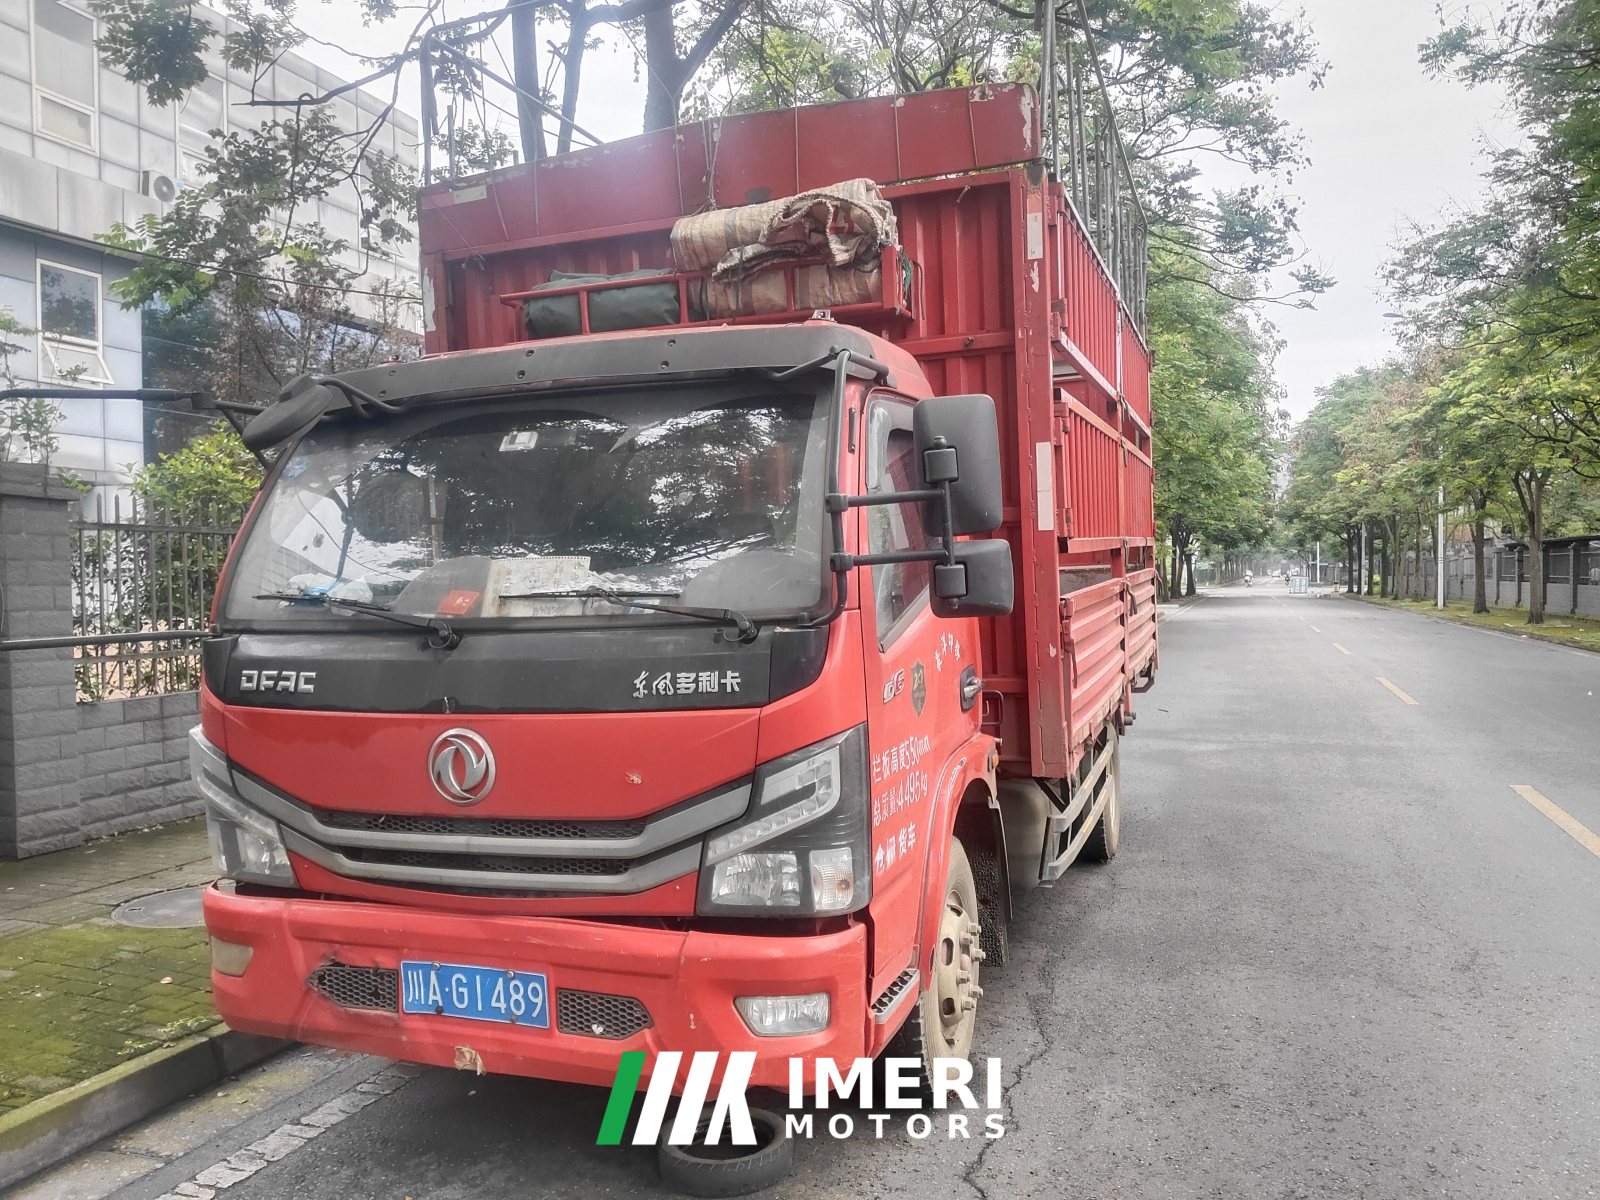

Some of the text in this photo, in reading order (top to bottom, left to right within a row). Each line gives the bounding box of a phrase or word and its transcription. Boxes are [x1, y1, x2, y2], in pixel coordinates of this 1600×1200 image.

[240, 670, 317, 694] DFAC
[633, 670, 741, 698] 东风多利卡
